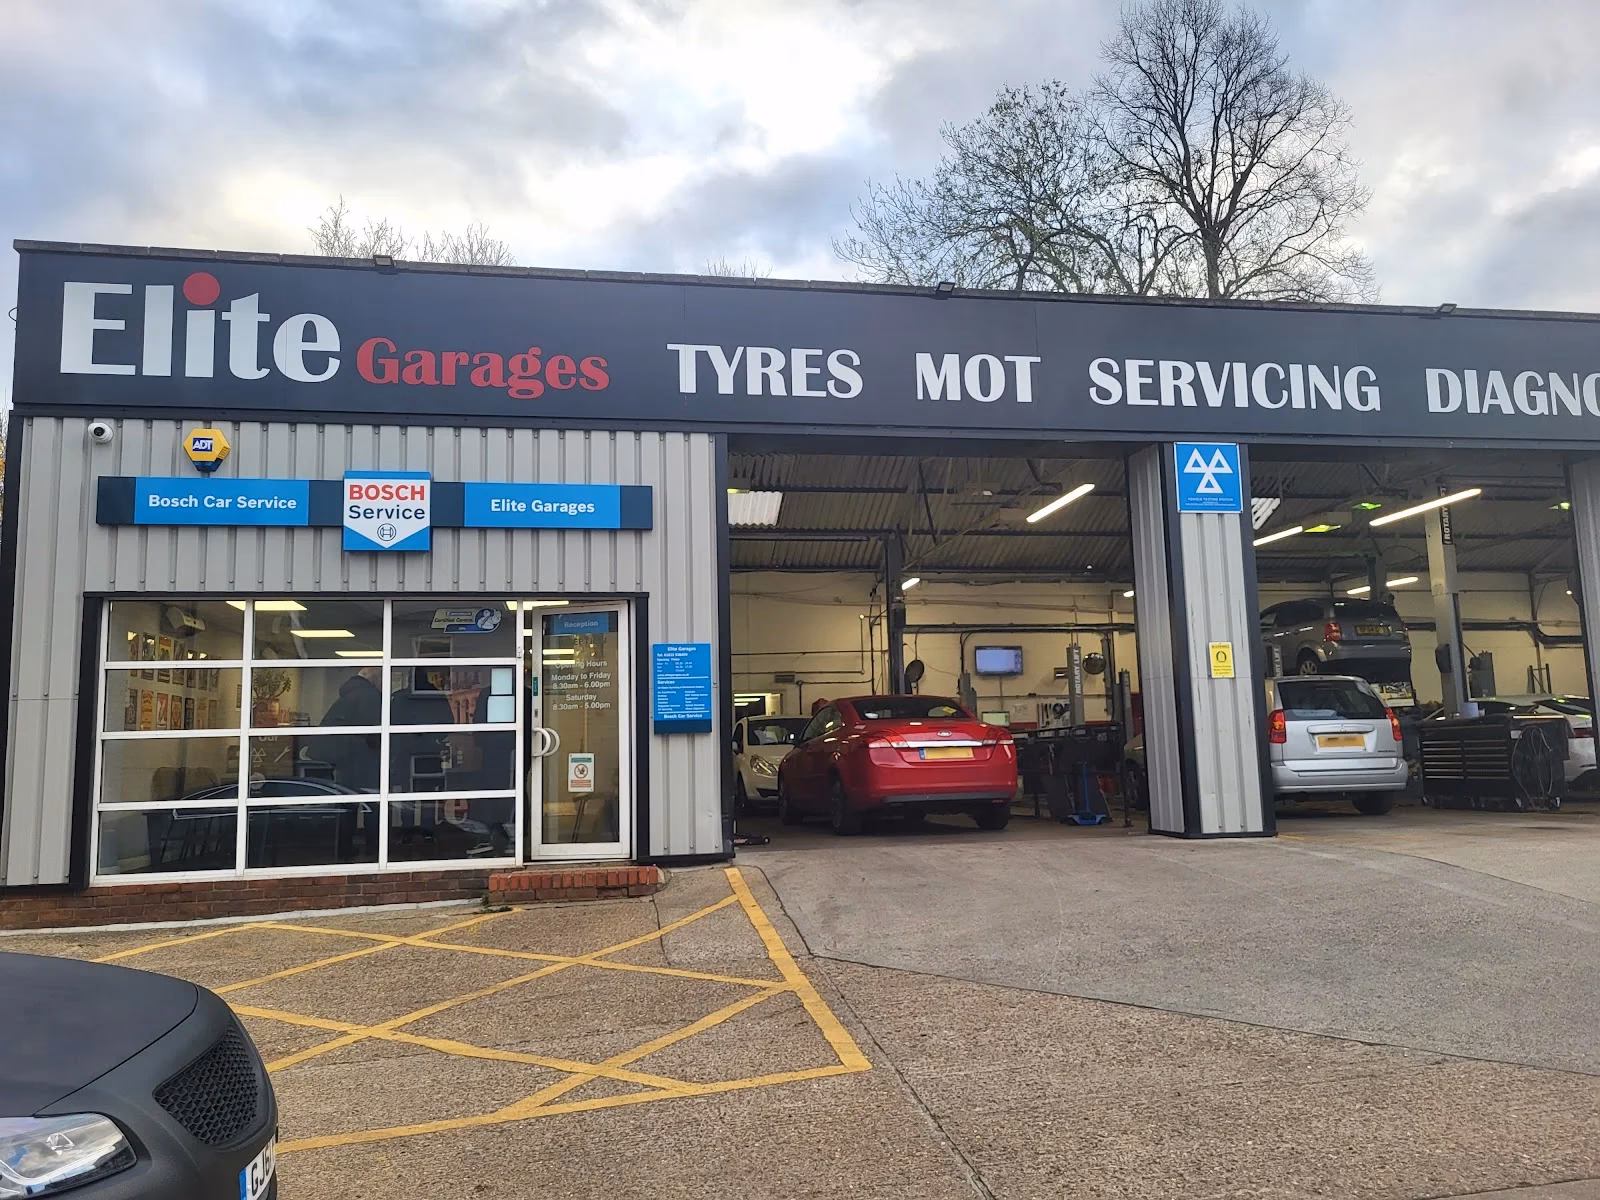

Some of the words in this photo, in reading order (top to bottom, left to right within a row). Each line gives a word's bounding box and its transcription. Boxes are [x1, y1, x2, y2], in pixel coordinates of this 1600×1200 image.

[59, 272, 340, 383] Elite
[355, 337, 611, 399] Garages
[666, 343, 864, 399] TYRES
[915, 352, 1042, 403] MOT
[1088, 357, 1381, 412] SERVICING
[193, 439, 213, 450] ADT
[349, 483, 425, 502] BOSCH
[148, 493, 198, 510] Bosch
[203, 495, 232, 509] Car
[236, 495, 297, 510] Service
[490, 498, 526, 513] Elite
[531, 499, 595, 516] Garages
[349, 504, 426, 521] Service
[564, 620, 598, 629] Reception
[586, 660, 608, 668] Hours
[551, 673, 578, 682] Monday
[589, 671, 611, 680] Friday
[566, 693, 597, 701] Saturday
